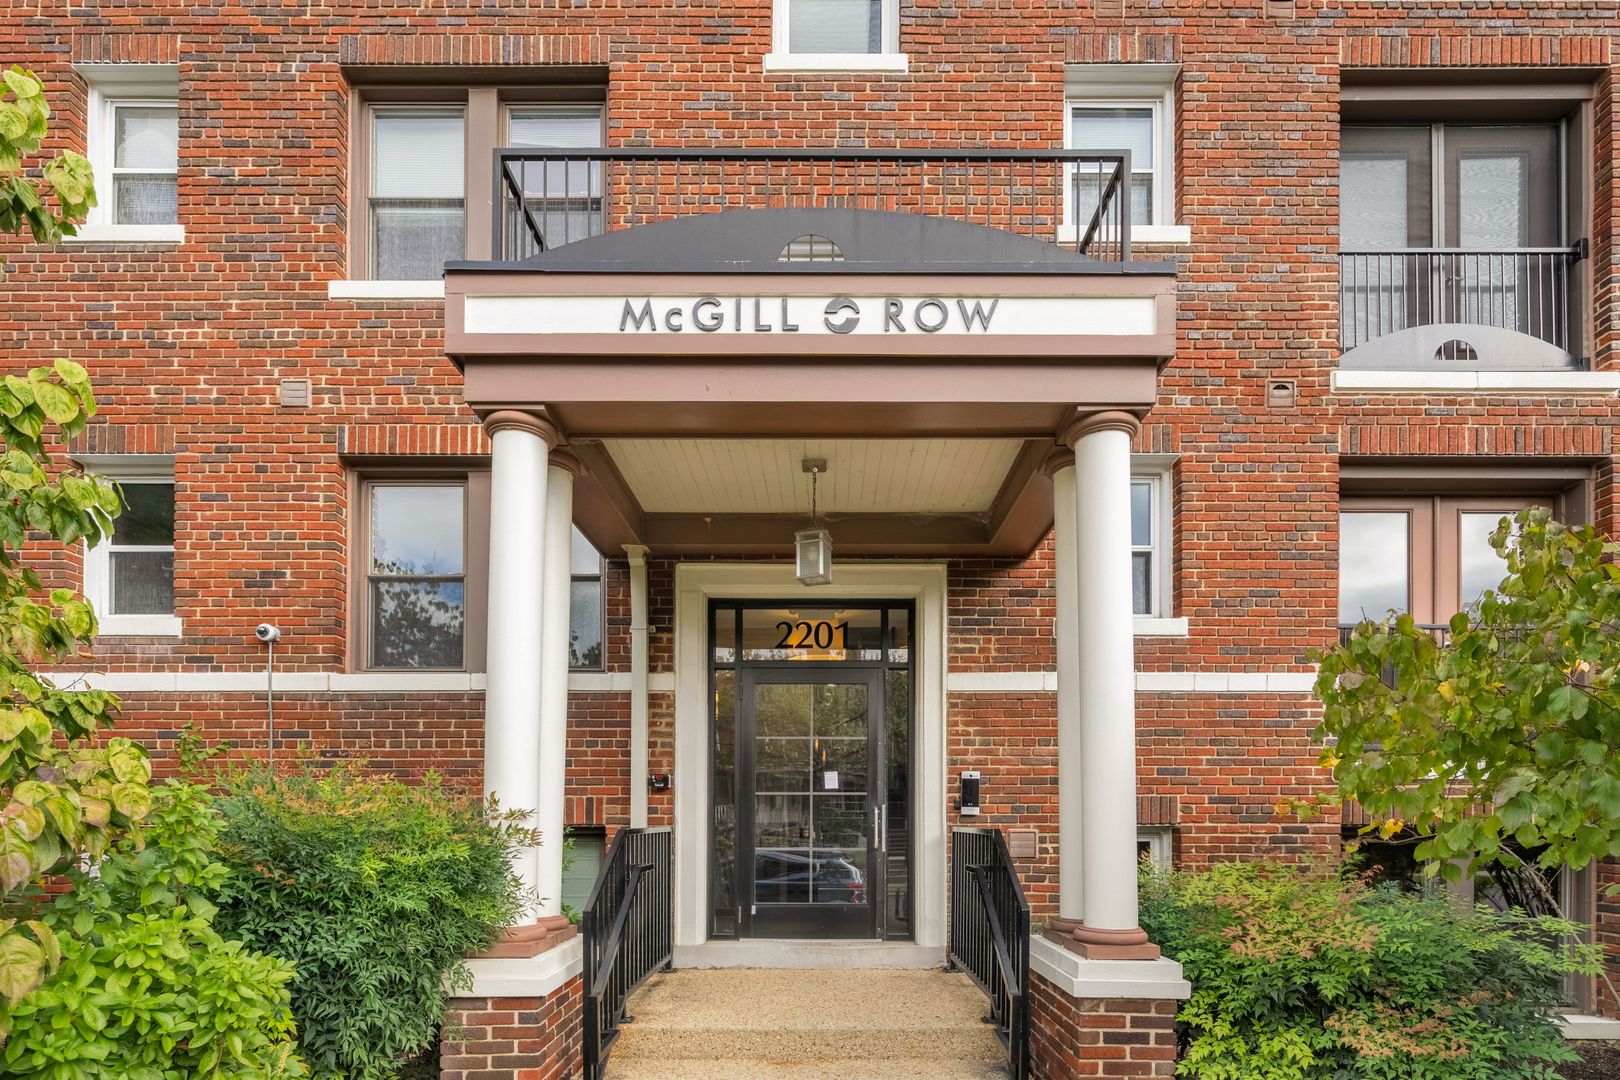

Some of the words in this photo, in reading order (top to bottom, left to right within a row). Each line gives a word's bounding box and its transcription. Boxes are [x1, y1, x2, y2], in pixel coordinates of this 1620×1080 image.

[619, 296, 800, 332] McGILL
[884, 296, 999, 332] ROW
[775, 621, 849, 649] 2201
